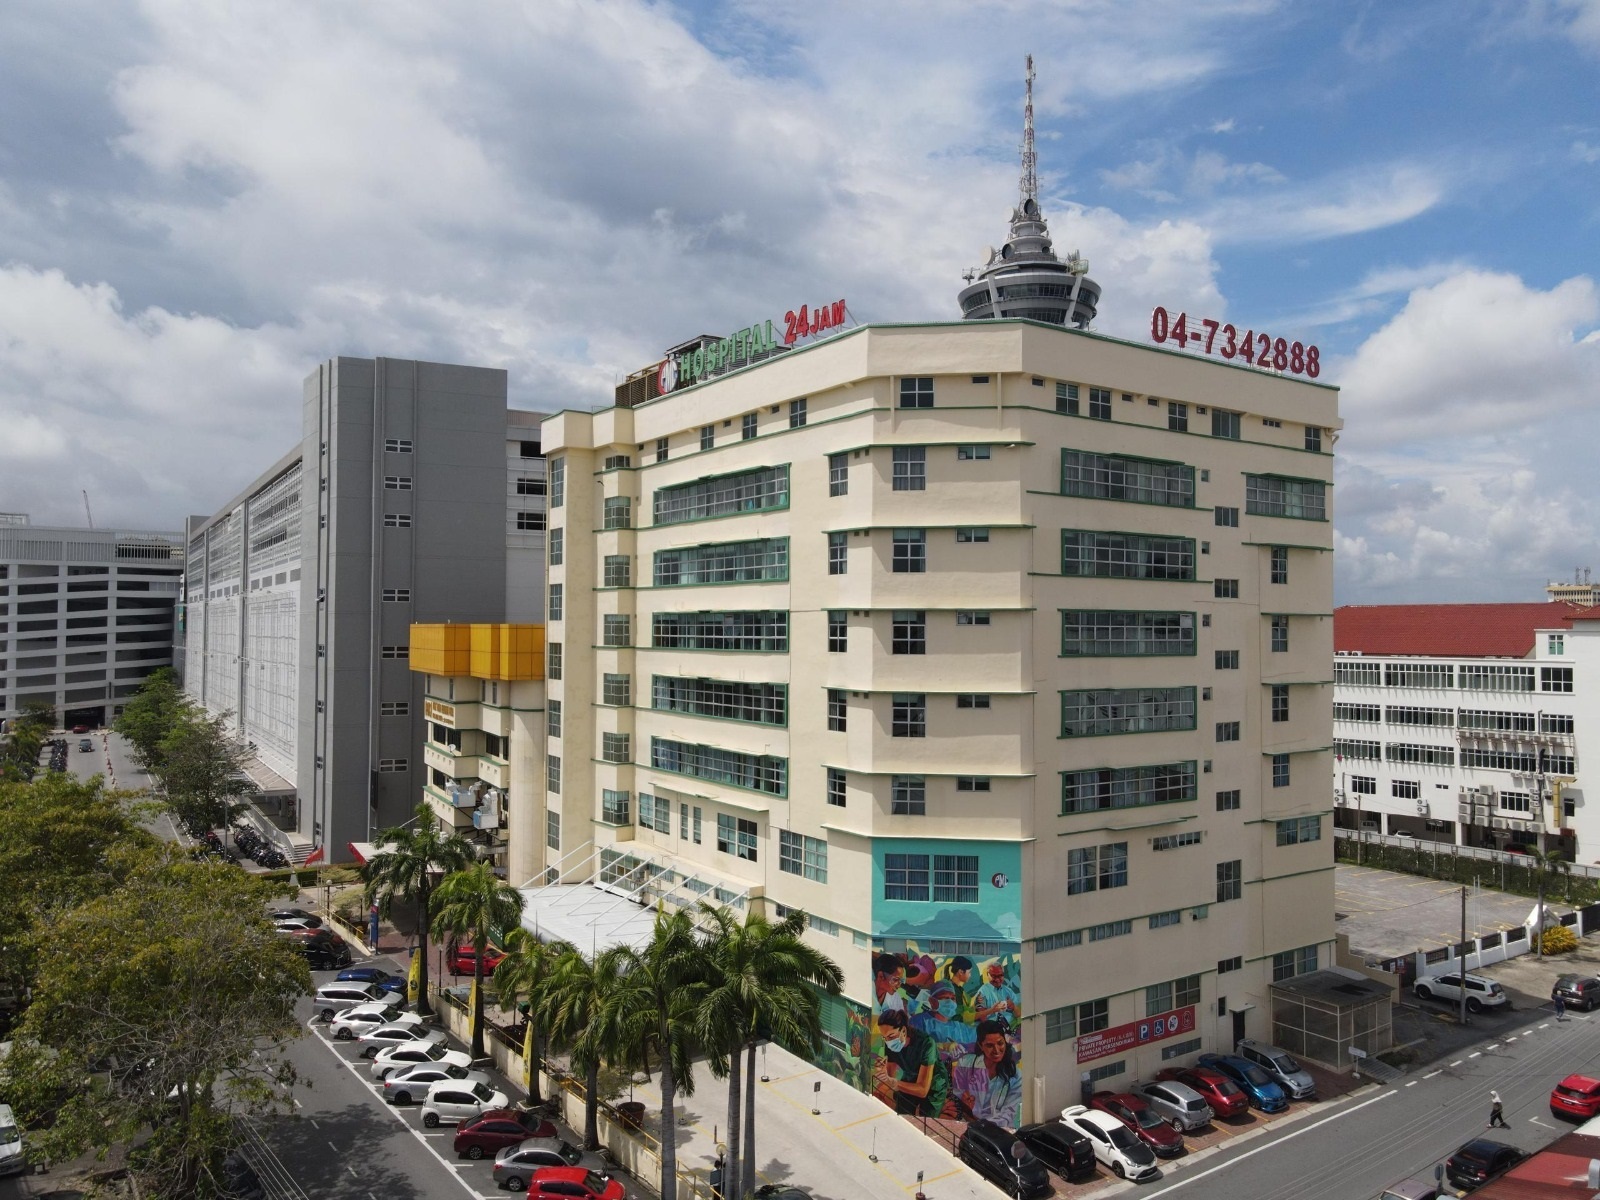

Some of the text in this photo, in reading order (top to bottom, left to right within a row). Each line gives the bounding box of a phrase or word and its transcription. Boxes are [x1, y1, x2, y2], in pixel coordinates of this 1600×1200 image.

[680, 319, 777, 382] HOSPITAL
[1151, 306, 1320, 379] 04-7342888
[1078, 1047, 1102, 1058] KAWASAN
[1079, 1042, 1095, 1052] PRIVATE
[1095, 1037, 1116, 1047] PROPERTY
